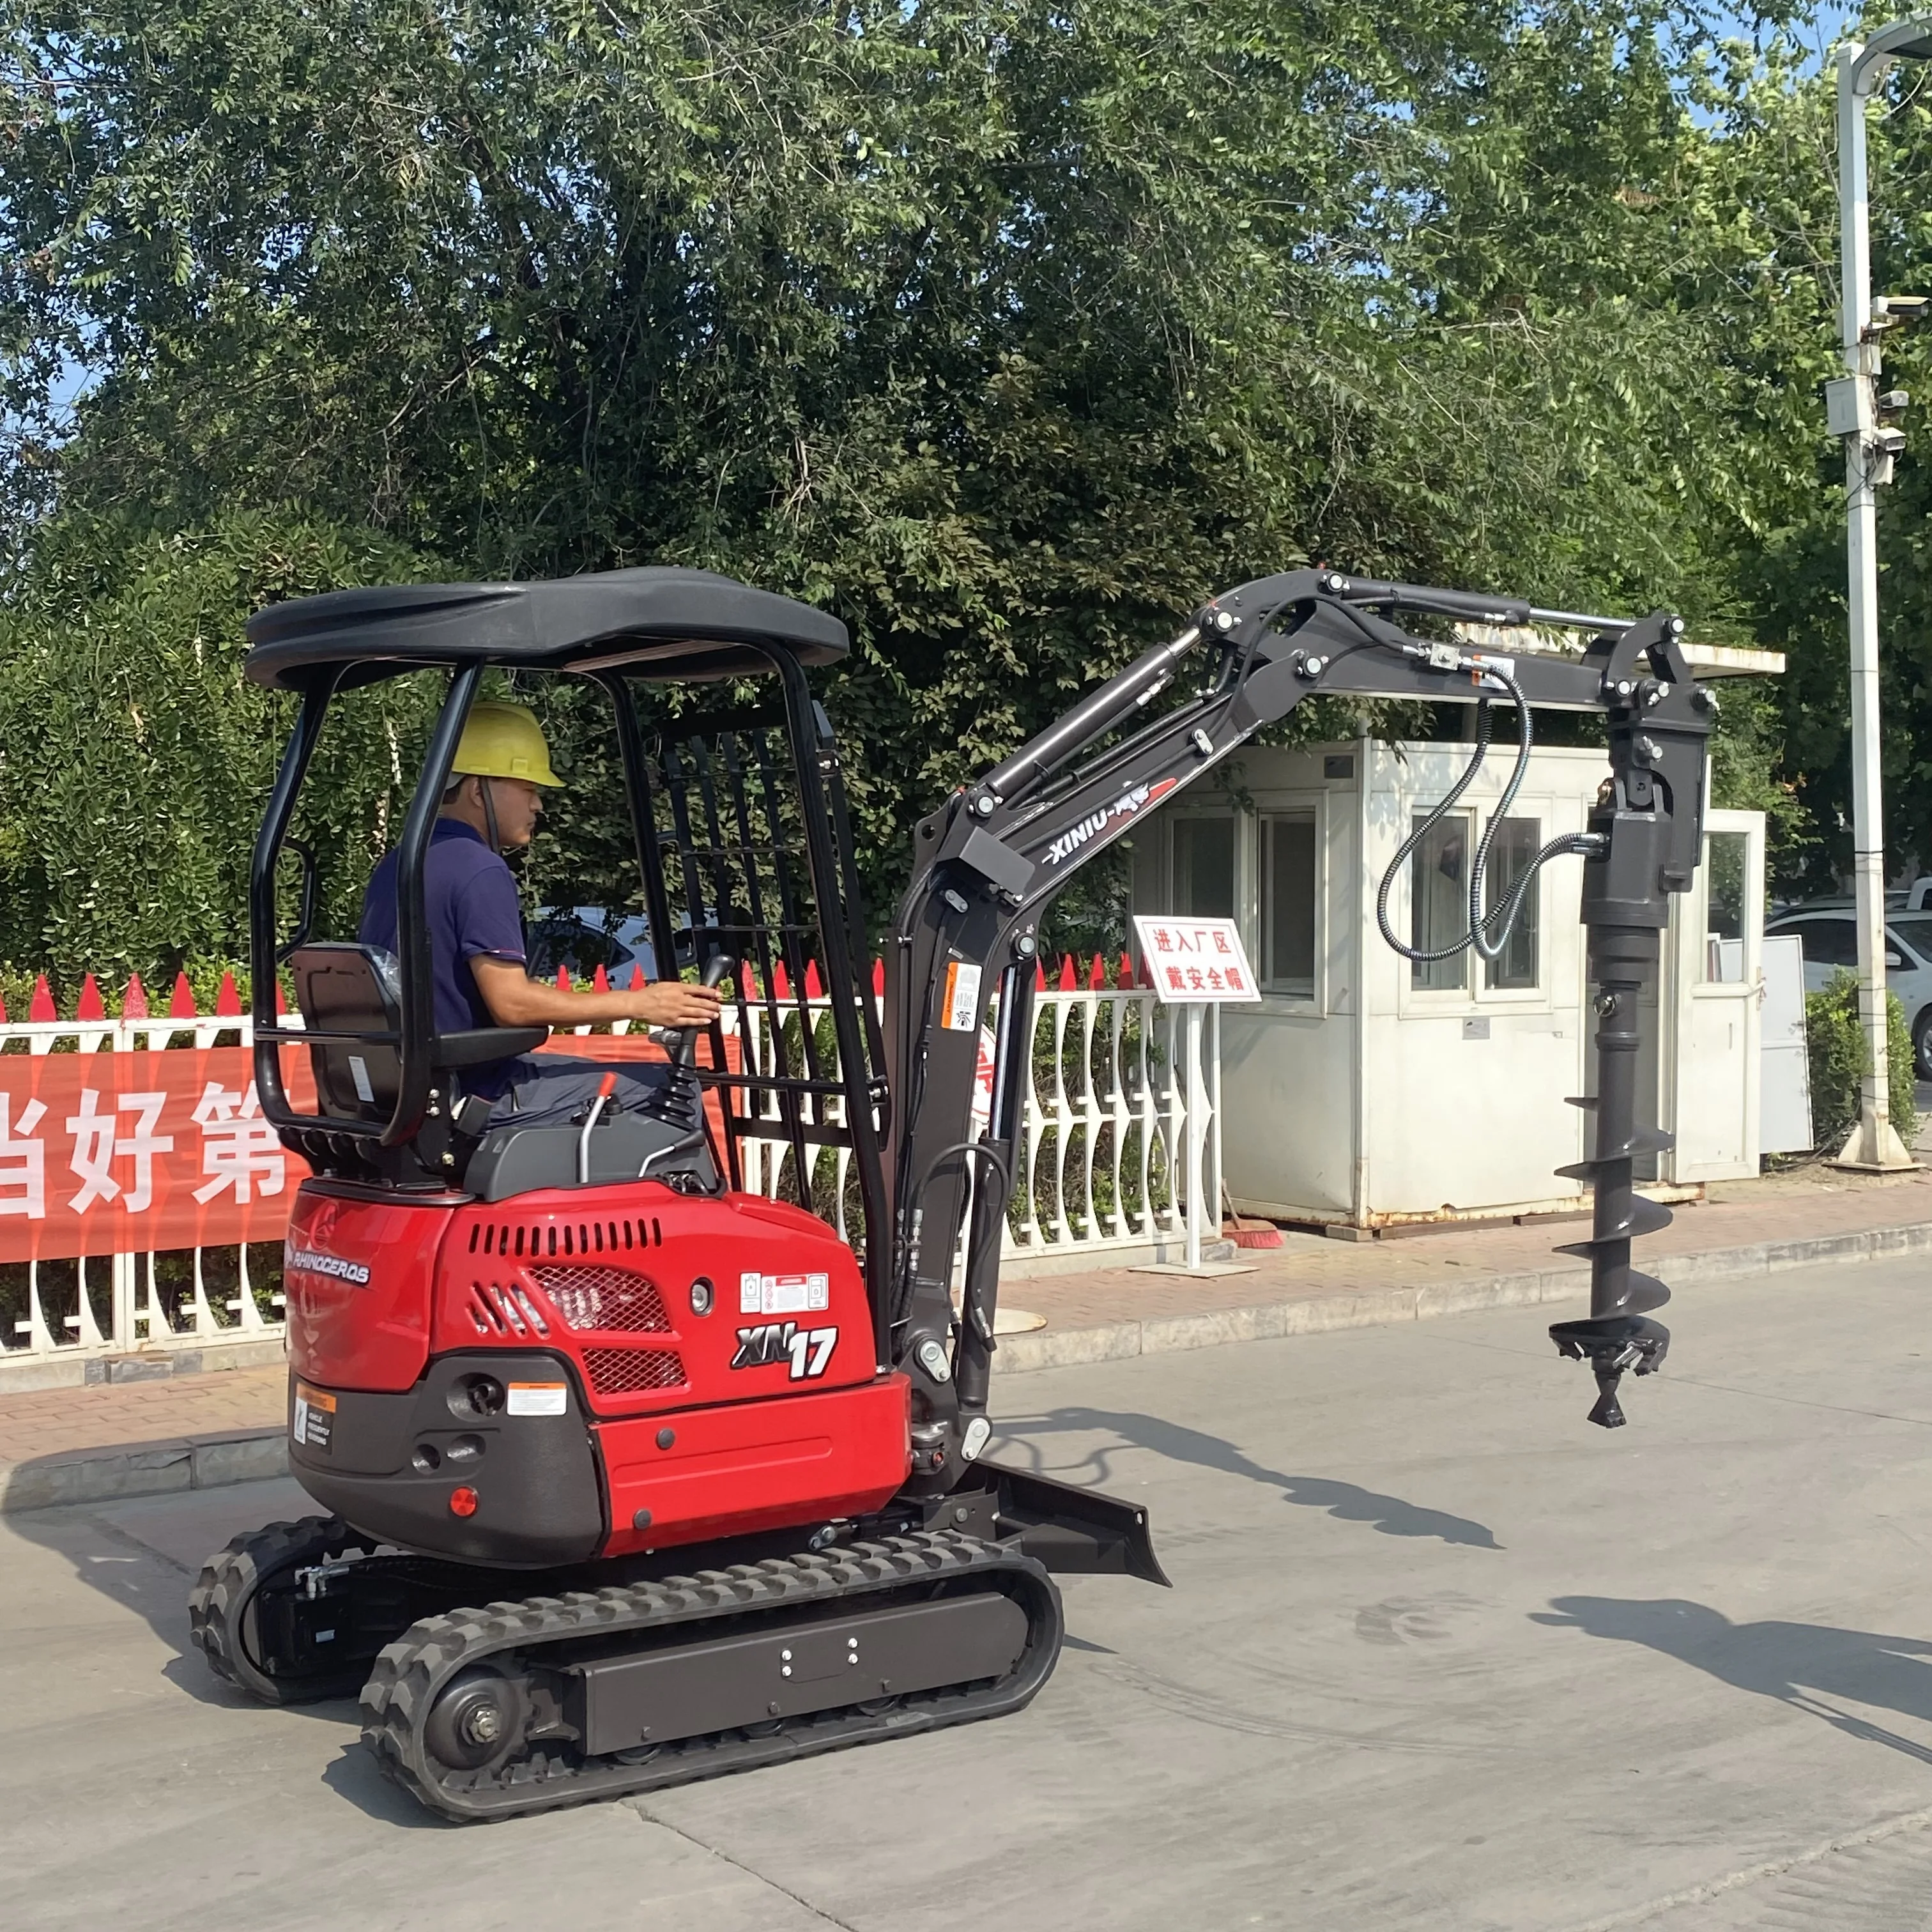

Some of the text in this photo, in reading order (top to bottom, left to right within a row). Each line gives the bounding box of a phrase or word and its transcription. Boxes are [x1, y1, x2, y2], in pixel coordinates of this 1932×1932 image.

[1153, 929, 1232, 953] 进入厂区
[1165, 966, 1245, 990] 戴安全帽
[293, 1252, 369, 1283] RHINOCEROS
